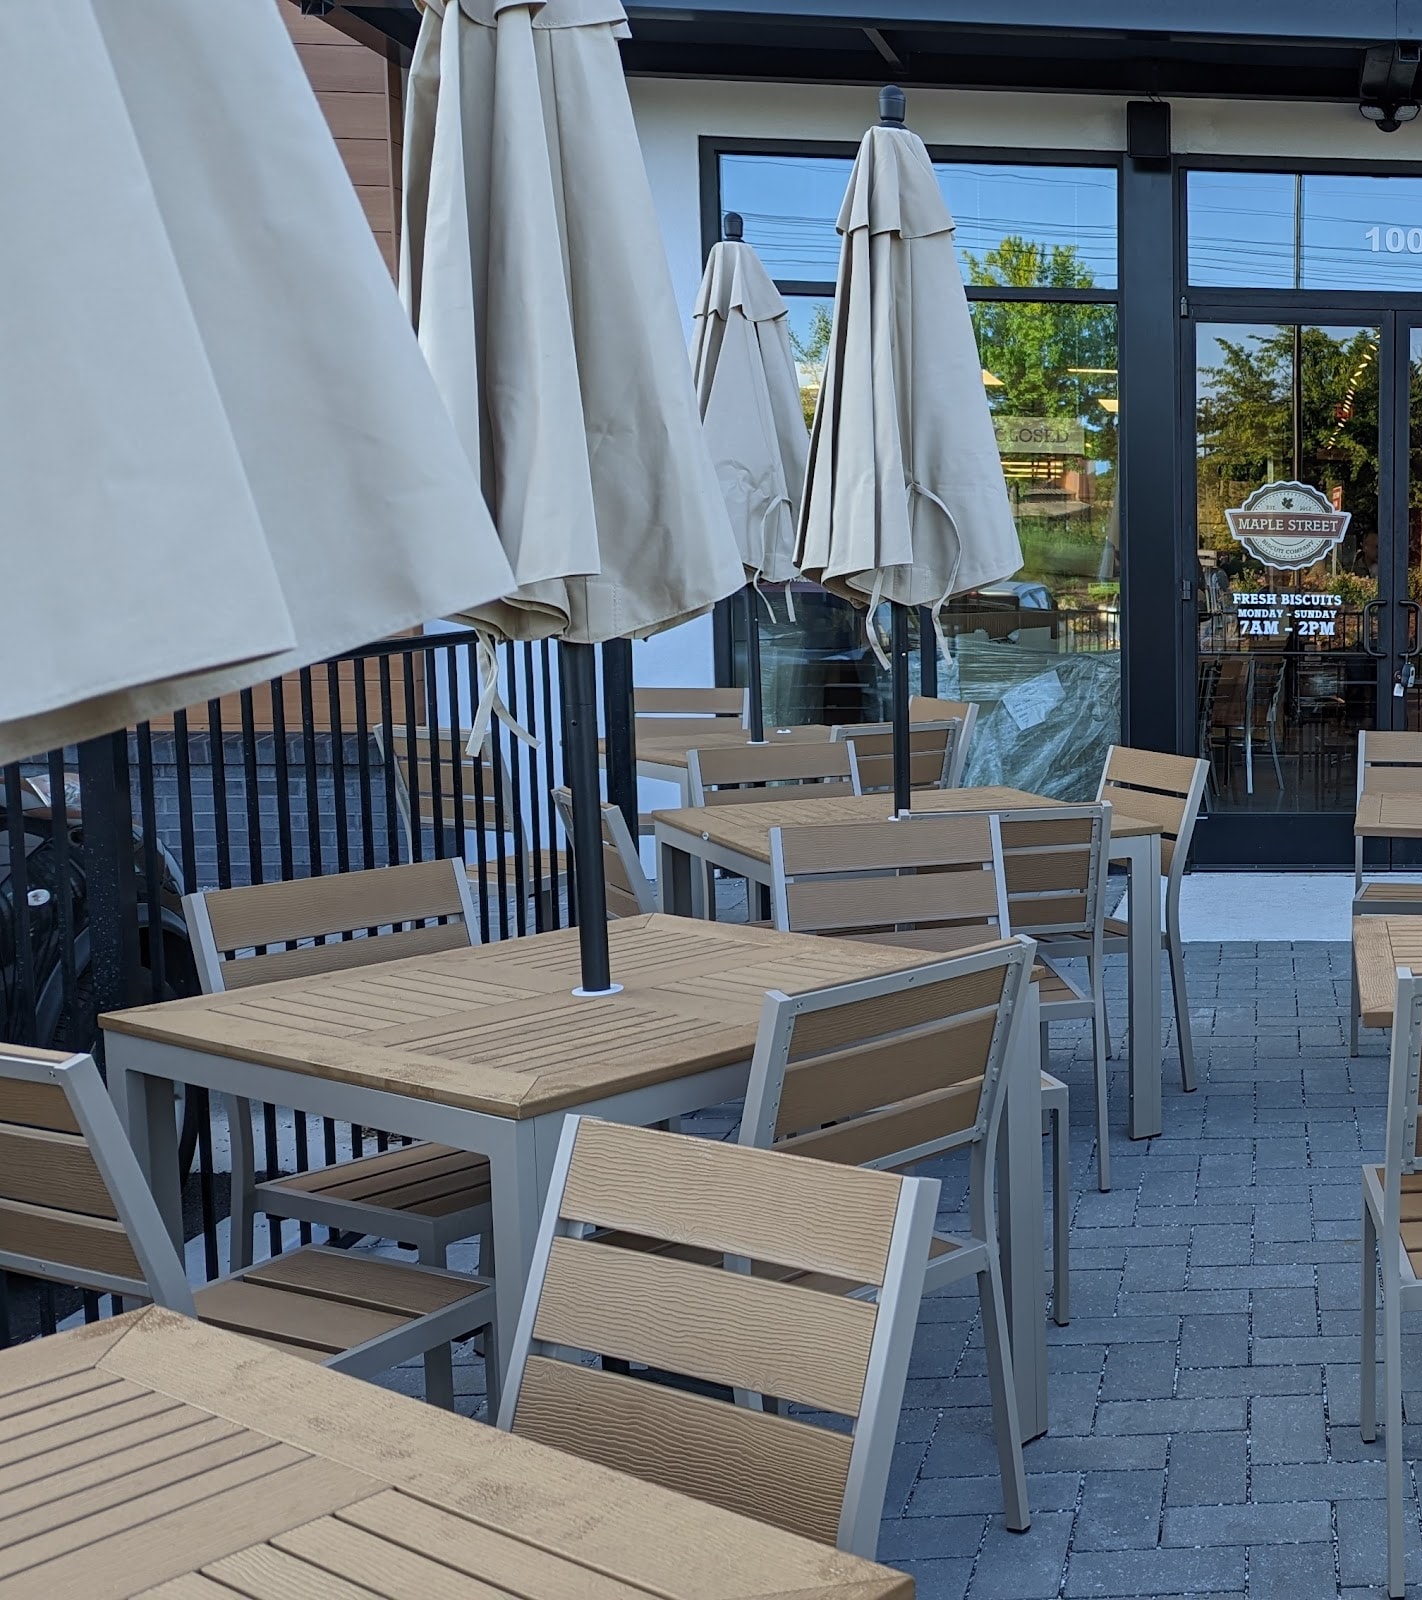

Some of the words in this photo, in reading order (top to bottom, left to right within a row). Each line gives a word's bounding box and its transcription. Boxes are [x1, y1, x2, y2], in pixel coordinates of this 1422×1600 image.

[995, 428, 1069, 443] CLOSED
[1238, 518, 1285, 531] MAPLE
[1288, 519, 1339, 532] STREET
[1232, 593, 1278, 605] FRESH
[1281, 594, 1342, 606] BISCUITS
[1237, 609, 1284, 618] MONDAY
[1294, 610, 1337, 619] SUNDAY
[1239, 620, 1280, 635] 7AM
[1298, 621, 1336, 635] 2PM
